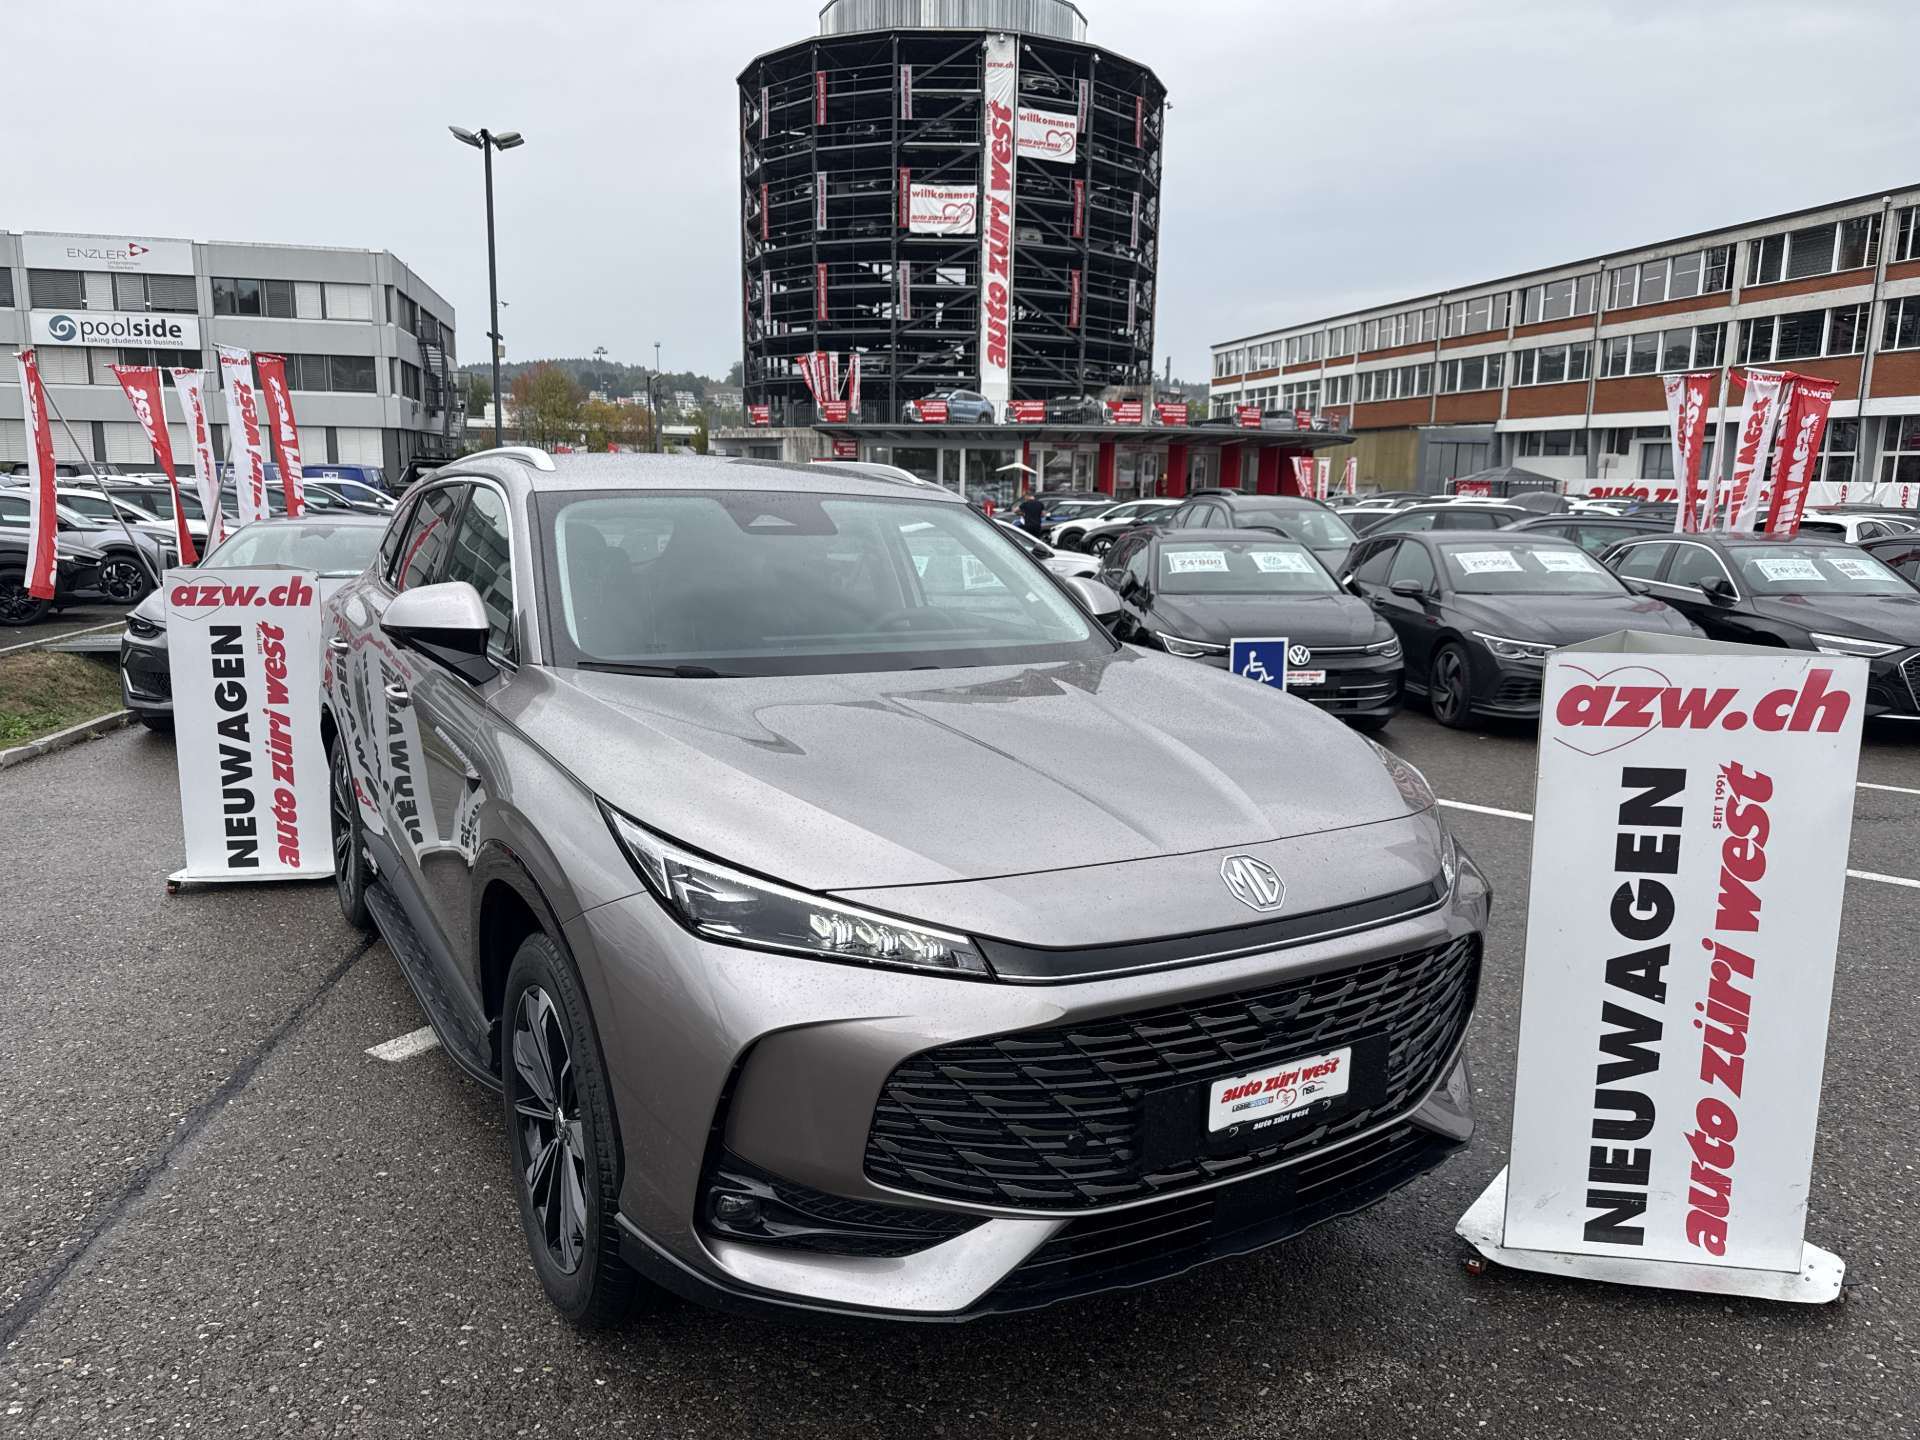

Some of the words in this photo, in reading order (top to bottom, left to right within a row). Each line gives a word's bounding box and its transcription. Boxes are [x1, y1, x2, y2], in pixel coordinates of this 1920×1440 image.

[988, 99, 1013, 191] west
[1019, 114, 1076, 129] willkommen
[911, 190, 976, 199] willkommen
[67, 248, 128, 260] ENZLER
[983, 193, 1010, 281] züri
[80, 318, 182, 342] poolside
[87, 337, 110, 345] taking
[984, 281, 1009, 369] auto
[221, 355, 251, 366] azw.ch
[233, 378, 261, 446] west
[1588, 482, 1649, 501] auto
[171, 576, 313, 607] azw.ch
[260, 620, 290, 705] west
[1556, 668, 1851, 733] azw.ch
[209, 625, 260, 869] NEUWAGEN
[263, 709, 295, 786] züri
[1714, 773, 1726, 801] 1991
[271, 787, 301, 868] auto
[1712, 805, 1724, 830] SEIT
[1715, 760, 1774, 932] west
[1227, 857, 1279, 905] MG
[1583, 766, 1687, 1246] NEUWAGEN
[1694, 937, 1755, 1096] züri
[1221, 1080, 1263, 1104] auto
[1262, 1068, 1301, 1093] züri
[1301, 1057, 1340, 1082] west
[1252, 1119, 1273, 1130] auto
[1272, 1112, 1291, 1125] züri
[1291, 1107, 1310, 1119] west
[1683, 1097, 1738, 1257] auto
